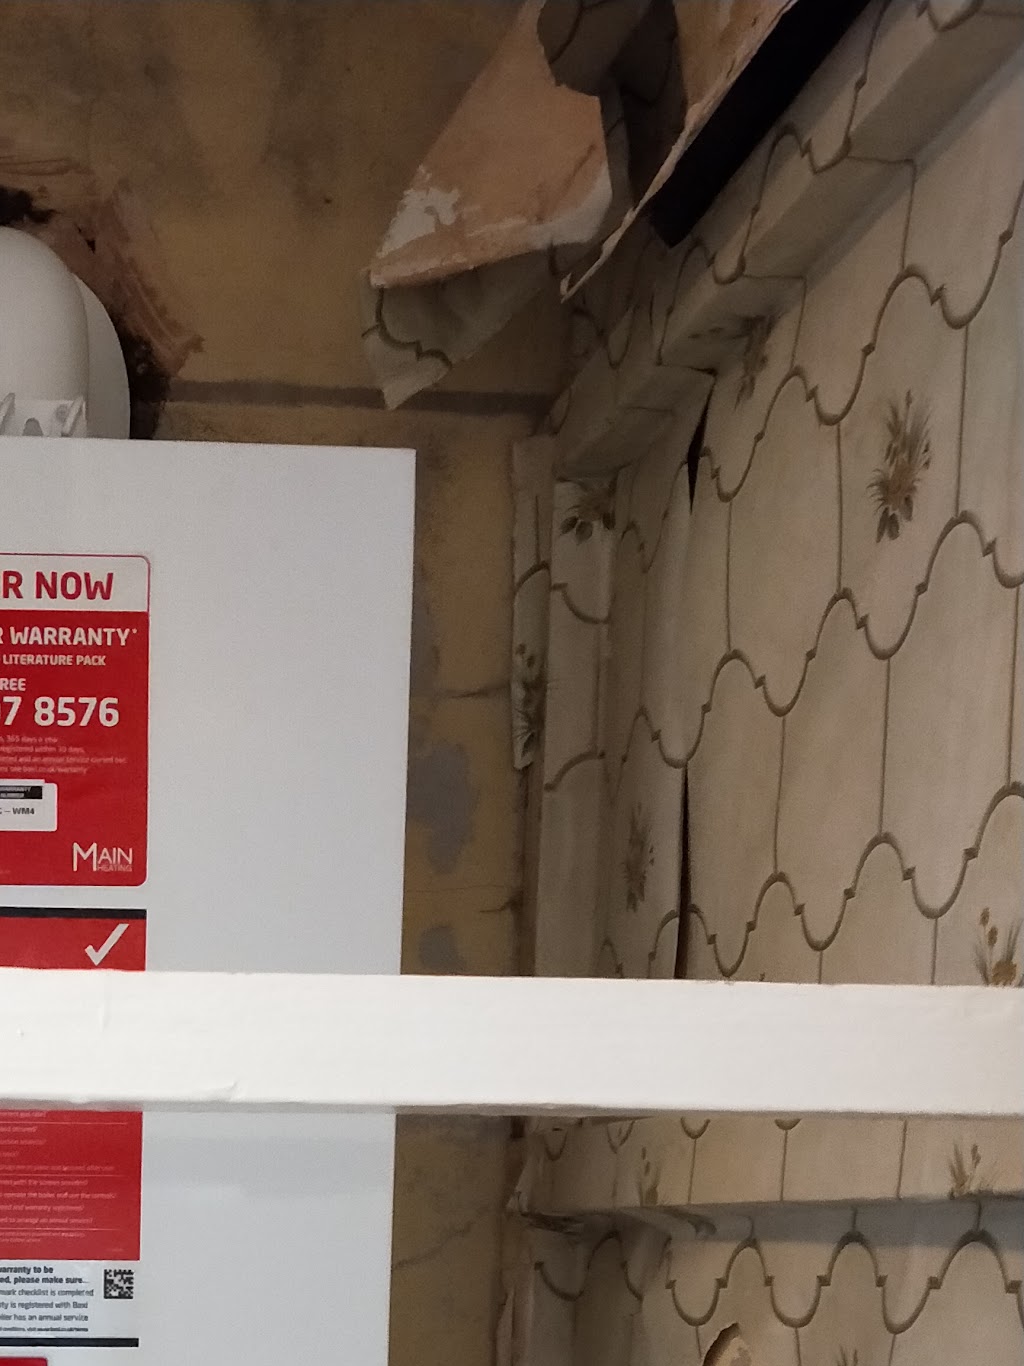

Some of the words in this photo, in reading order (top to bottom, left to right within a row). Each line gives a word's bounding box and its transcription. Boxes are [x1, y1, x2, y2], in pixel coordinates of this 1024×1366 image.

[35, 571, 114, 600] NOW
[3, 655, 73, 666] LITERATURE
[76, 655, 106, 666] PACK
[34, 697, 119, 727] 8576
[73, 842, 132, 872] MAIN
[33, 1266, 42, 1274] to
[43, 1266, 54, 1274] be
[13, 1276, 40, 1285] please
[18, 1288, 49, 1296] checklist
[50, 1288, 56, 1296] is
[10, 1301, 16, 1309] is
